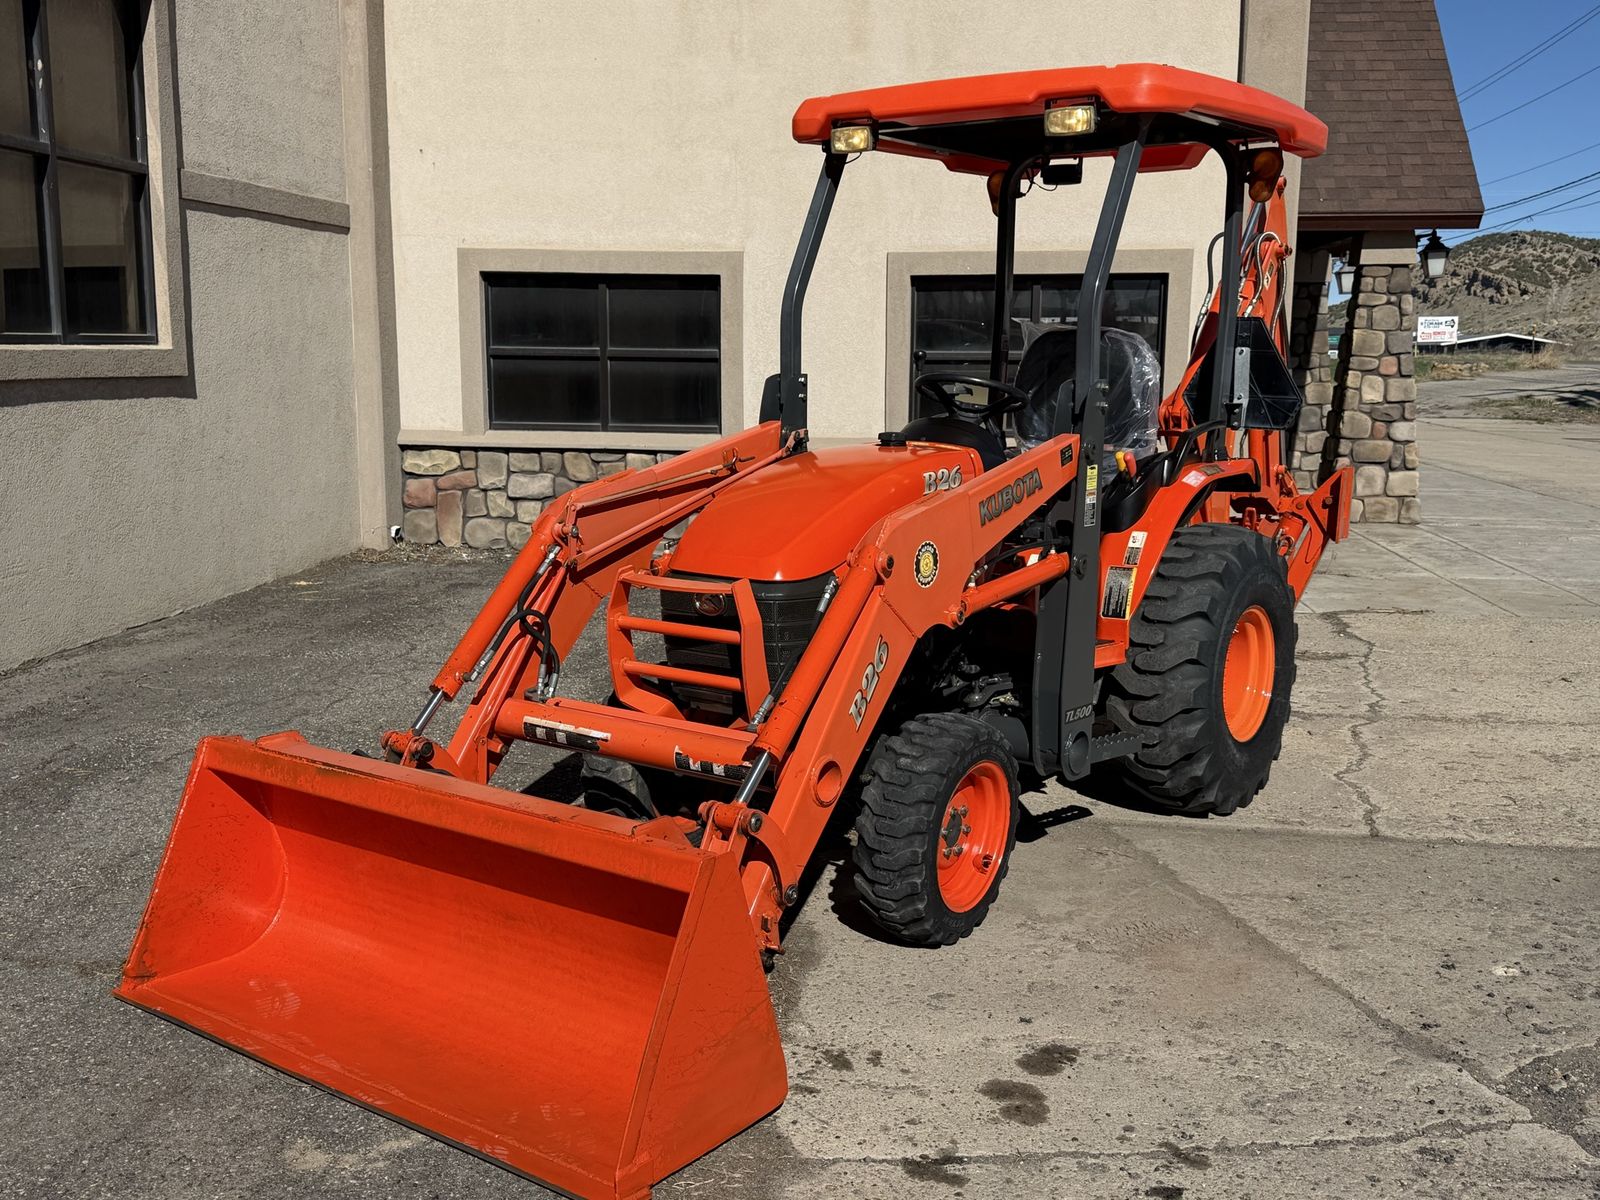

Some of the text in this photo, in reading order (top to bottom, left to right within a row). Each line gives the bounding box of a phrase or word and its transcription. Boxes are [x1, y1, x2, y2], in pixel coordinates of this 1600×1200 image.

[922, 464, 962, 496] B26
[979, 468, 1043, 528] KUBOTA
[848, 634, 889, 733] B26
[1065, 704, 1092, 723] TL500
